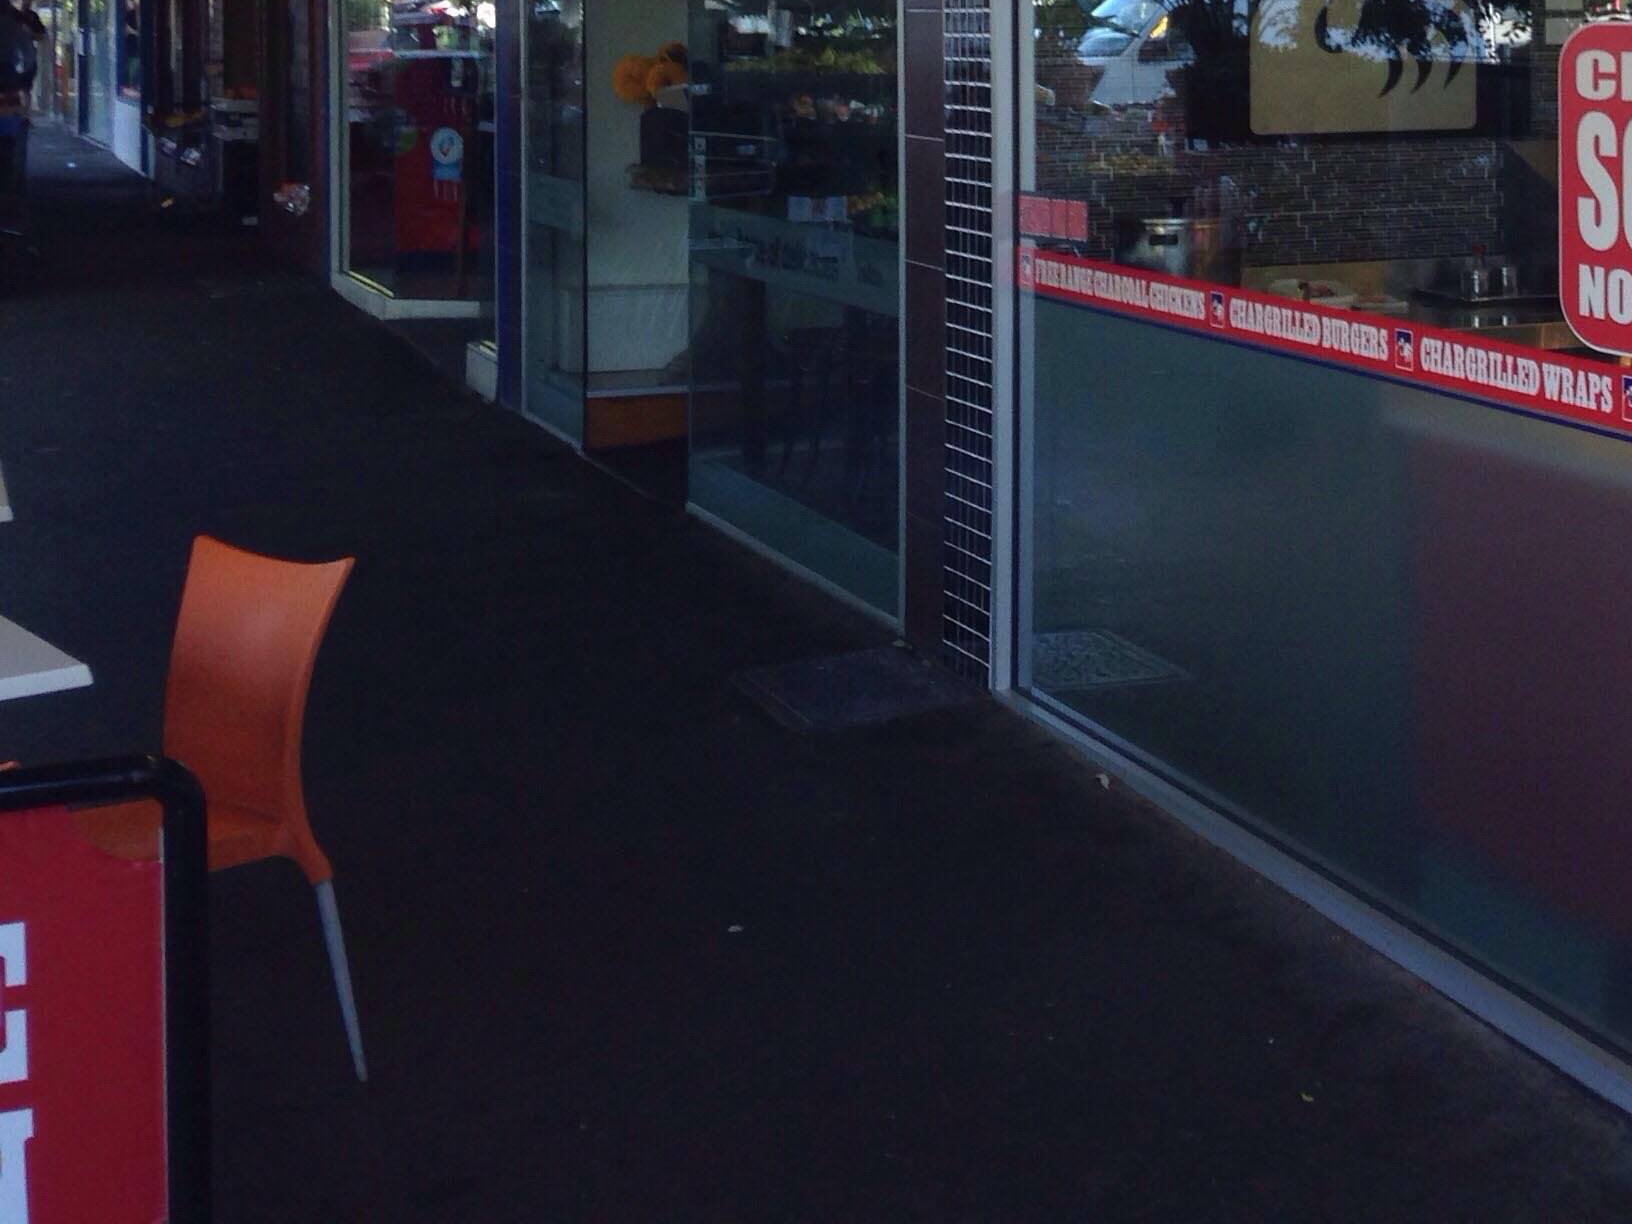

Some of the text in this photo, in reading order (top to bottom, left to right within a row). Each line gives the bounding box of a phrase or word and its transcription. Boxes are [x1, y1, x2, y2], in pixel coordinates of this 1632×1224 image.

[1093, 269, 1150, 309] CHARCOAL
[1229, 297, 1389, 362] CHARGRILLED BURGERS
[1420, 336, 1614, 414] CHARGRILLED WRAPS
